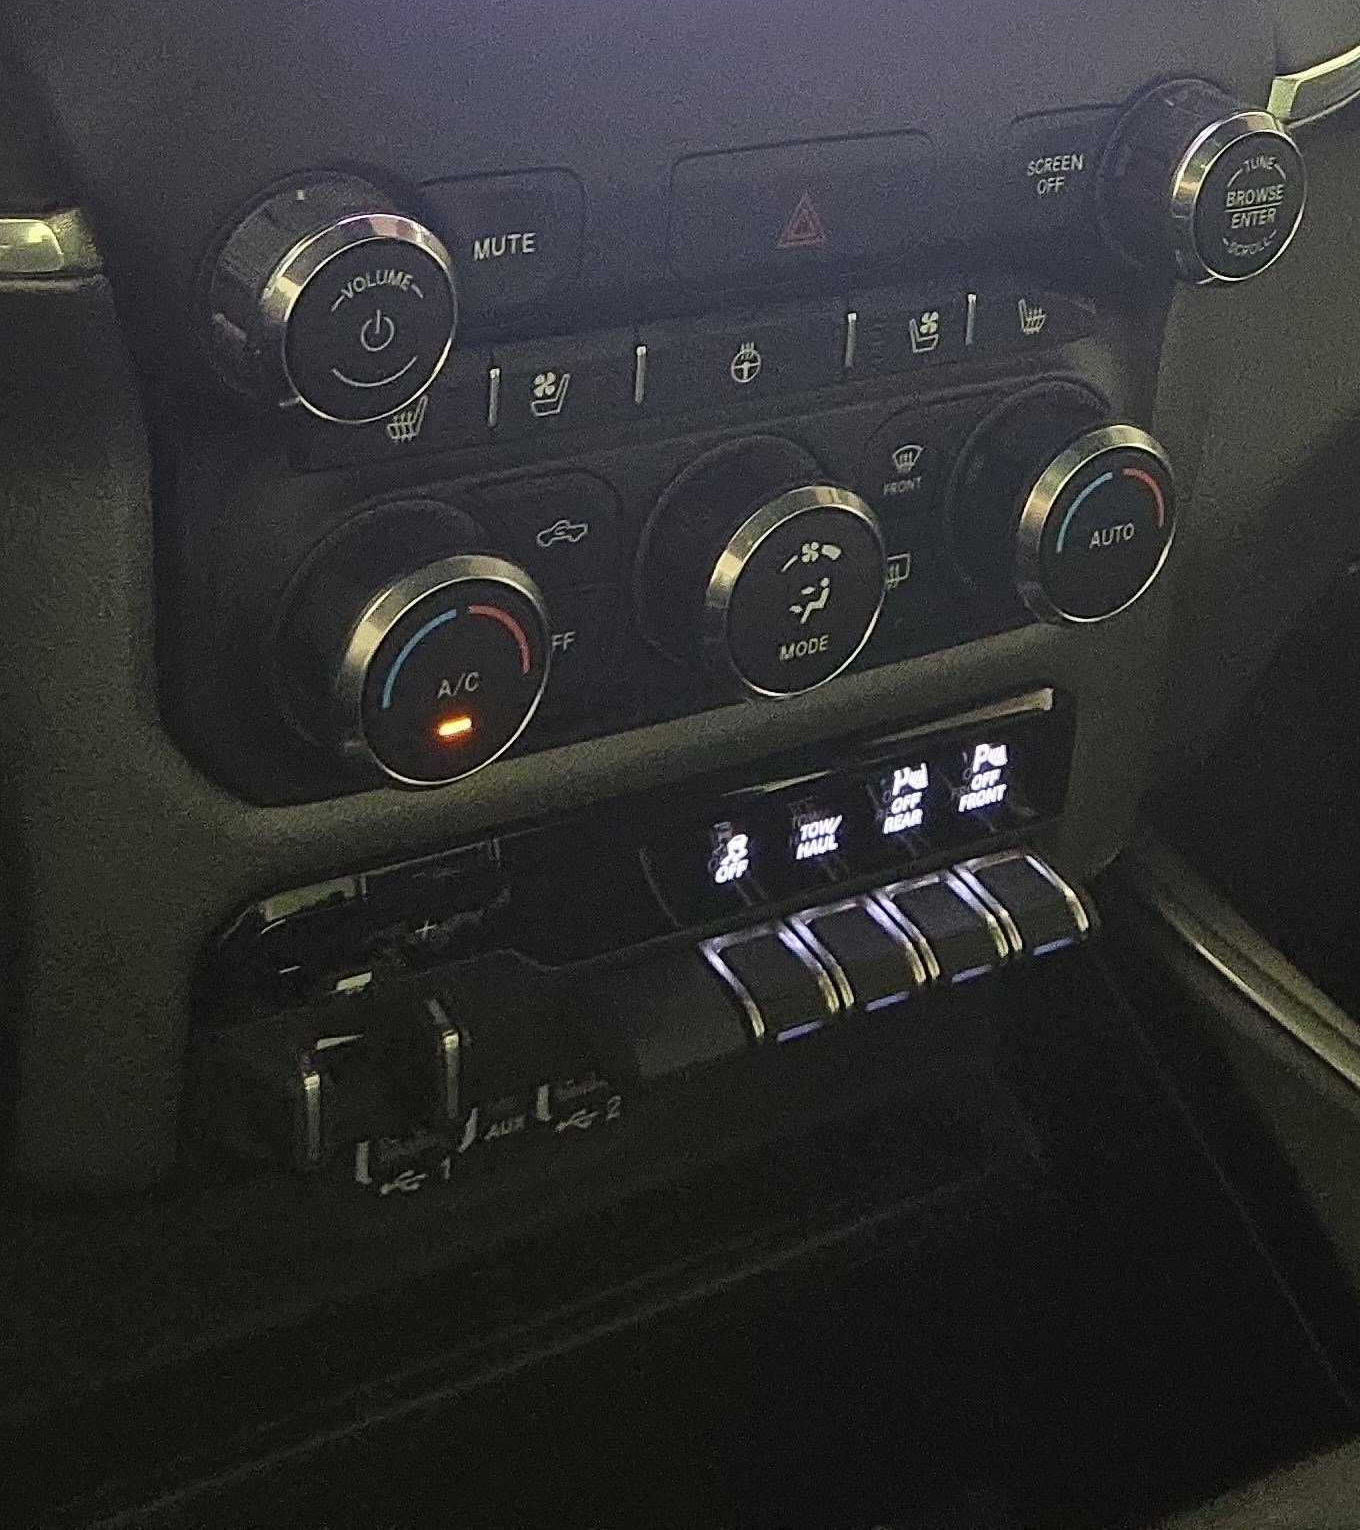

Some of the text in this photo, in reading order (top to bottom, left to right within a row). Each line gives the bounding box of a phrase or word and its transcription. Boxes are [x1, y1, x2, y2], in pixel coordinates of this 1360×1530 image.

[1026, 153, 1084, 176] SCREEN
[1243, 154, 1276, 171] TUNE
[1037, 176, 1065, 195] OFF
[1226, 184, 1285, 207] BROWSE
[1230, 207, 1277, 230] ENTER
[473, 232, 537, 261] MUTE
[340, 269, 413, 300] VOLUME
[883, 476, 923, 496] FRONT
[1090, 522, 1136, 550] AUTO
[552, 630, 576, 652] FF
[779, 634, 830, 662] MODE
[438, 671, 480, 699] A/C
[969, 769, 1002, 791] OFF
[890, 792, 923, 816] OFF
[957, 783, 1008, 813] FRONT
[800, 815, 843, 841] TOW/
[882, 808, 924, 835] REAR
[795, 835, 839, 861] HAUL
[714, 859, 749, 884] OFF
